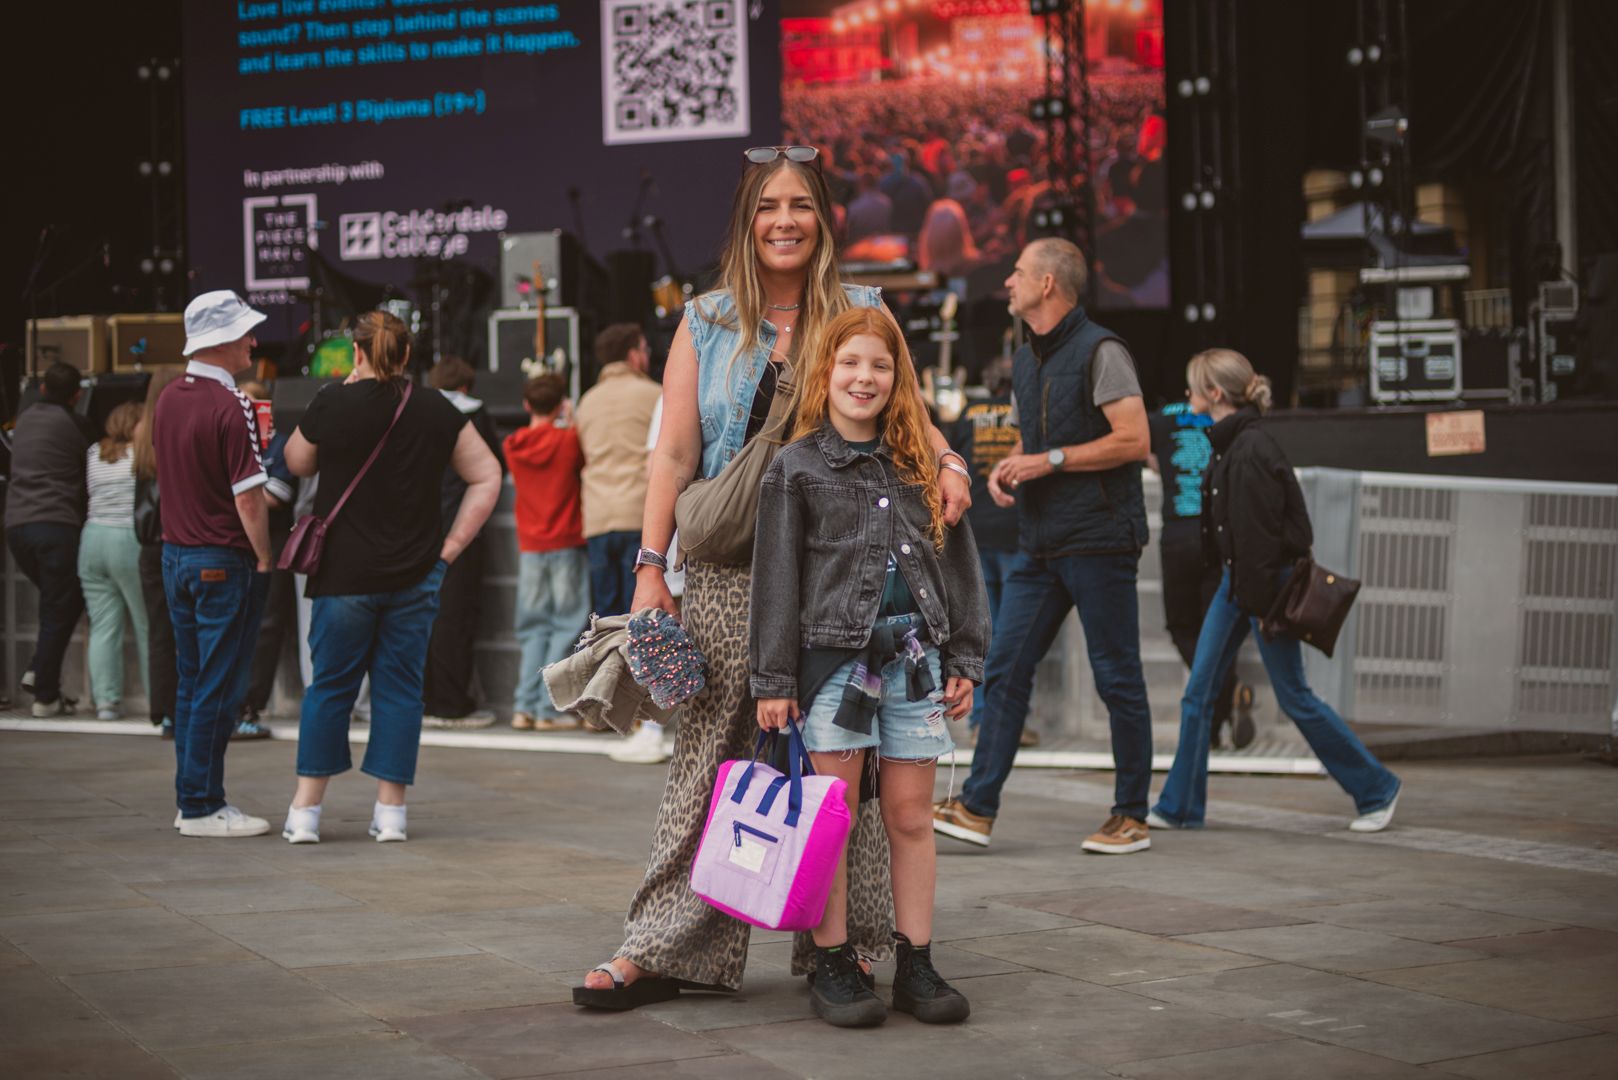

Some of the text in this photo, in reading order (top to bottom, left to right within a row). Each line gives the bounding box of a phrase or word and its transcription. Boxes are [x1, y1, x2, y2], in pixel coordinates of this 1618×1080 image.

[238, 2, 278, 20] Love
[281, 0, 314, 15] live
[239, 4, 560, 47] sound? Then step behind the scenes
[239, 31, 580, 74] and learn the skills to make it happen.
[239, 106, 286, 128] FREE
[289, 103, 336, 126] Level
[340, 101, 353, 123] 3
[356, 98, 431, 124] Diploma
[244, 160, 384, 190] In partnership with
[265, 211, 298, 228] THE
